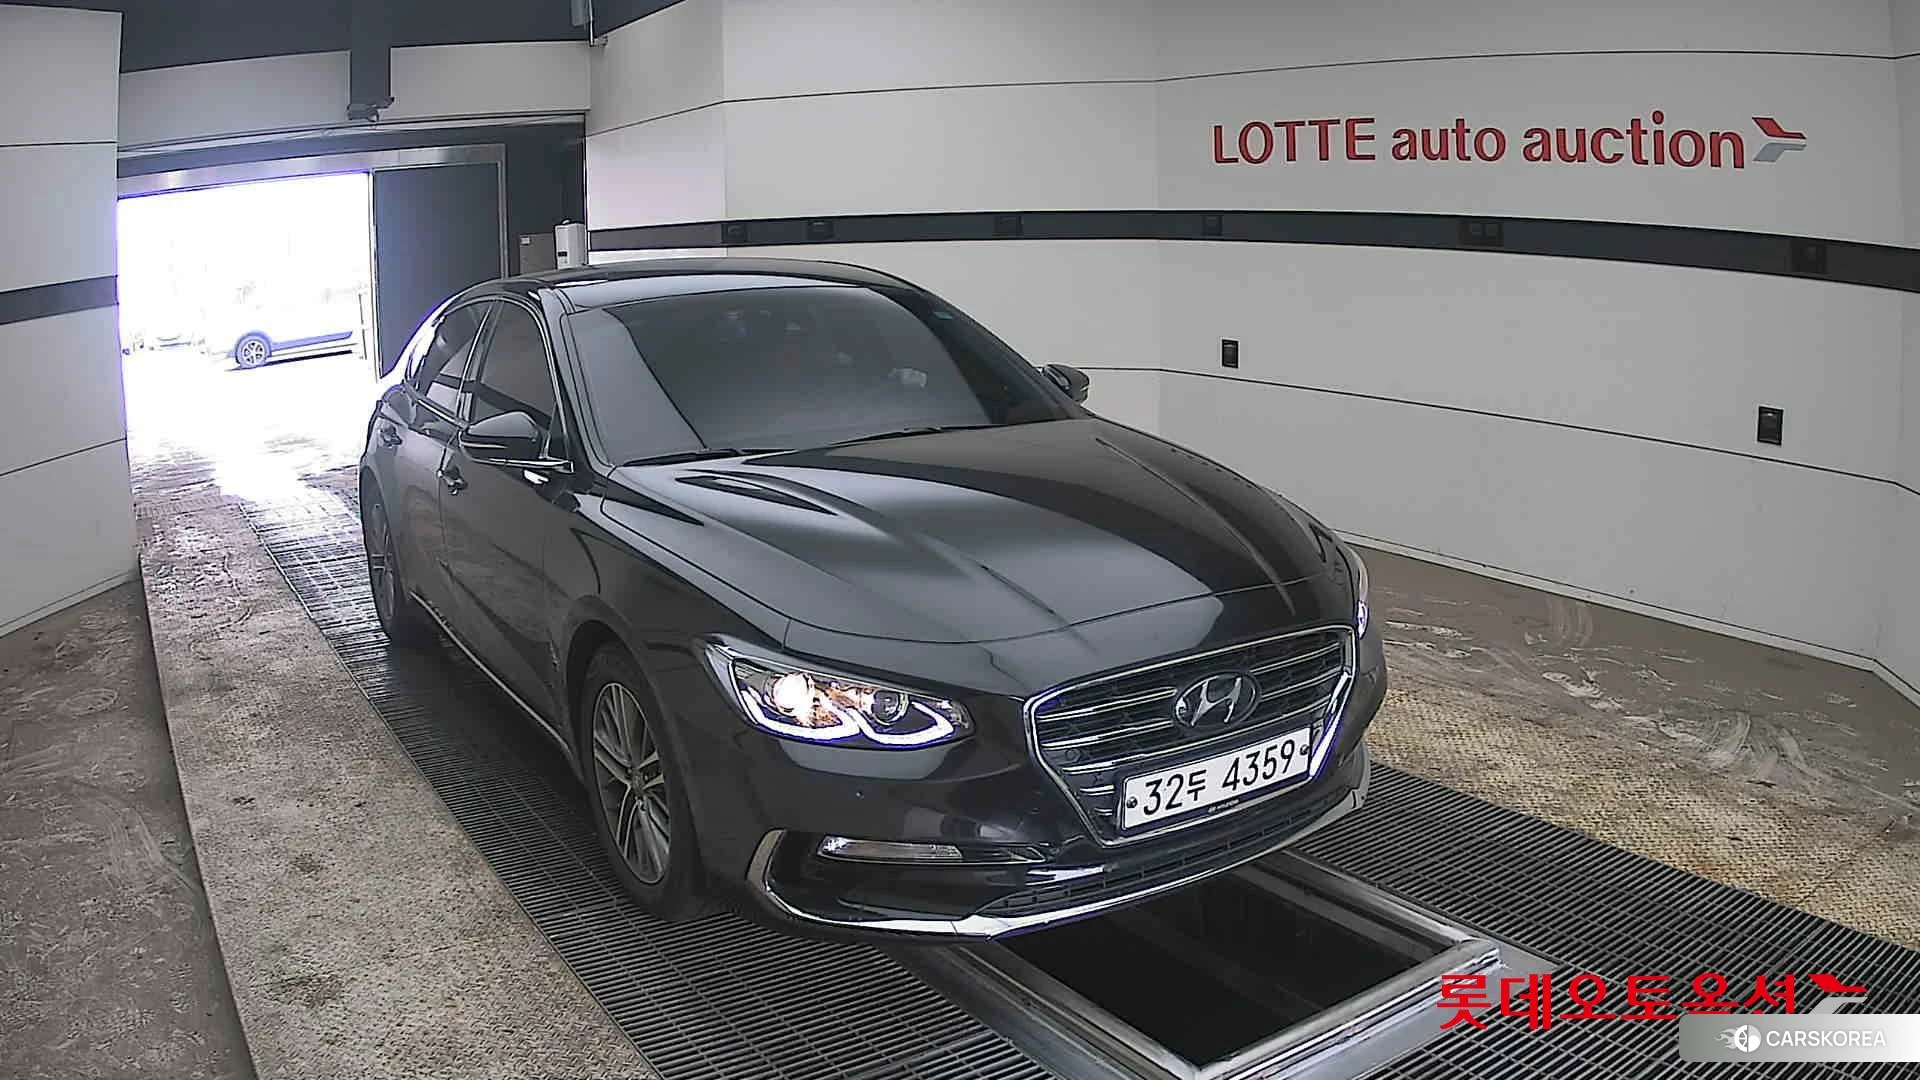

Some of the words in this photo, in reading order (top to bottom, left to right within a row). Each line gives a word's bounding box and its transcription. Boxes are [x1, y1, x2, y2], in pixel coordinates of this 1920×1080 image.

[1213, 116, 1376, 164] LOTTE
[1390, 118, 1507, 162] auto
[1522, 111, 1746, 169] auction
[1143, 769, 1207, 816] 32두
[1222, 739, 1295, 792] 4359
